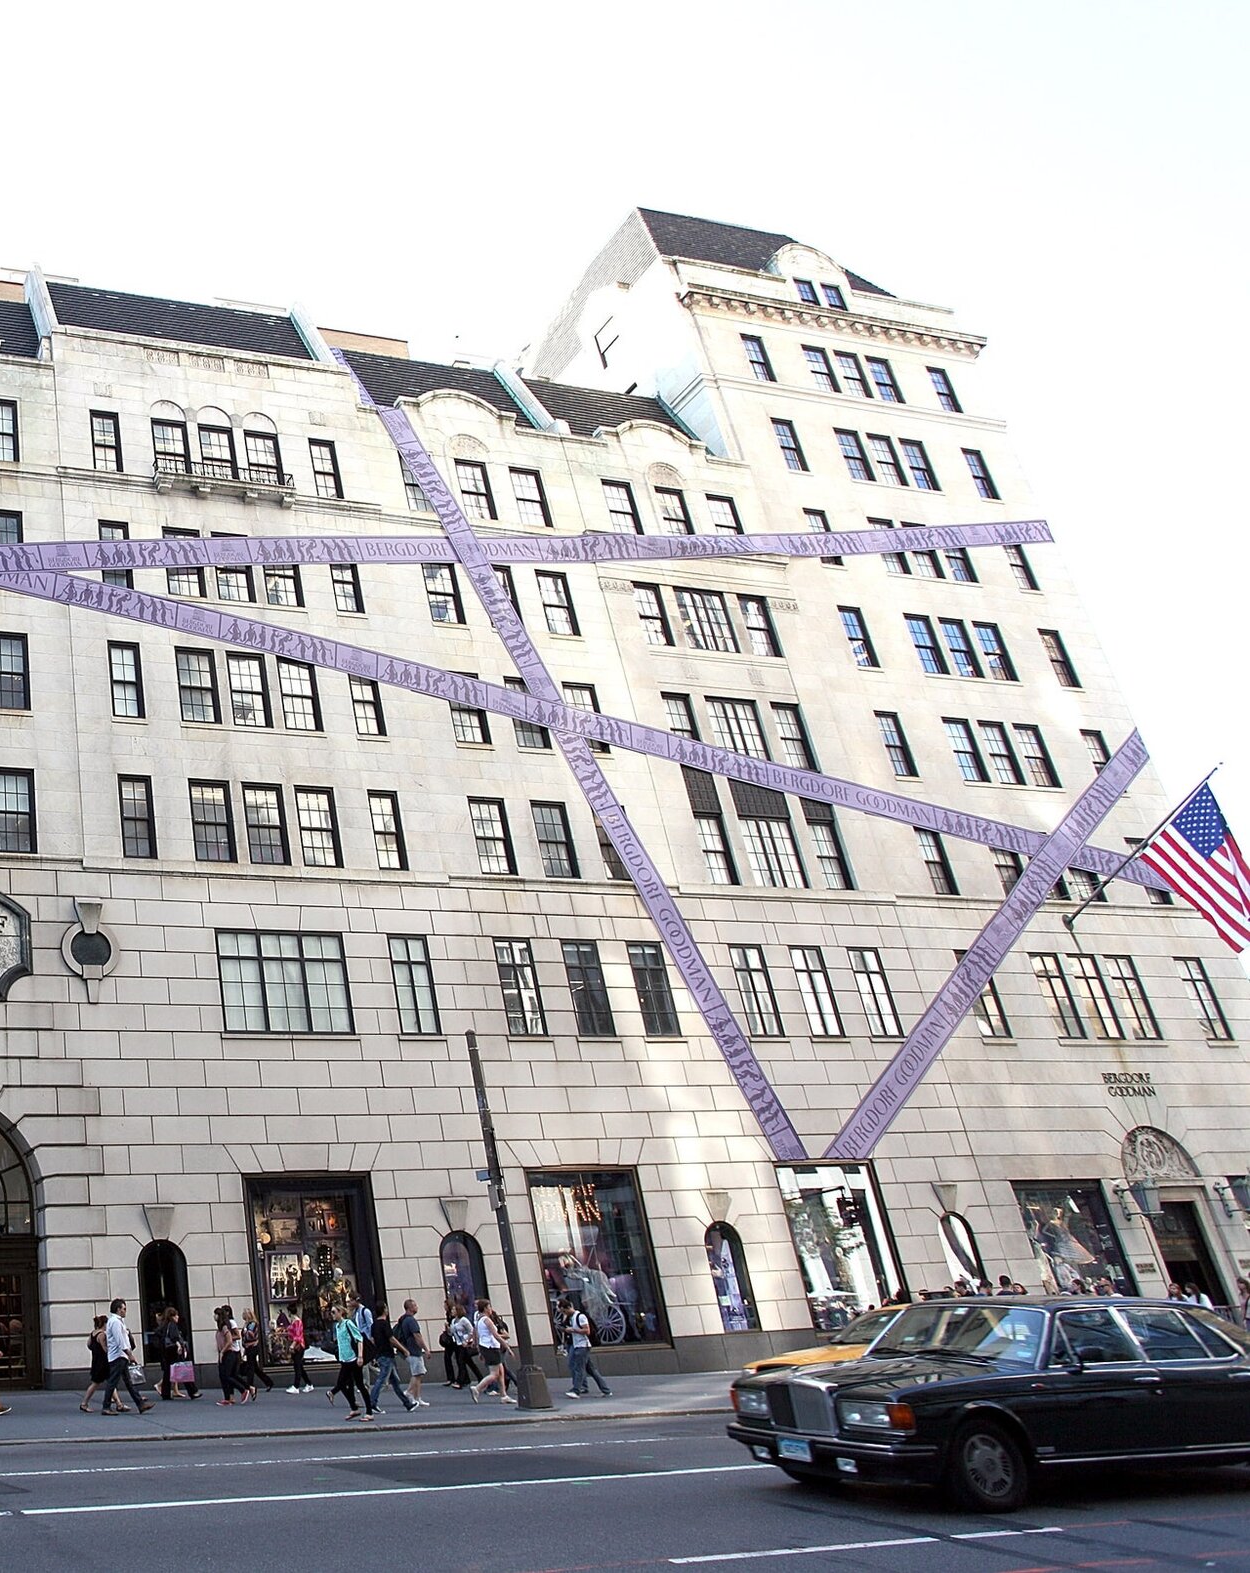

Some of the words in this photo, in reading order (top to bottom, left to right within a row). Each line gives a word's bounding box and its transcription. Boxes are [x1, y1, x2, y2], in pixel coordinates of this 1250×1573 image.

[365, 543, 448, 557] BERGDORF
[773, 770, 849, 802] BERGDORF
[856, 791, 931, 824] GOODMAN
[605, 813, 665, 900] BERGDORF
[658, 908, 717, 1003] GOODMAN
[842, 1081, 898, 1159] BERGDORF
[894, 1018, 946, 1086] GOODMAN
[1101, 1072, 1150, 1084] BERGDORF
[1108, 1086, 1157, 1097] GOODMAN
